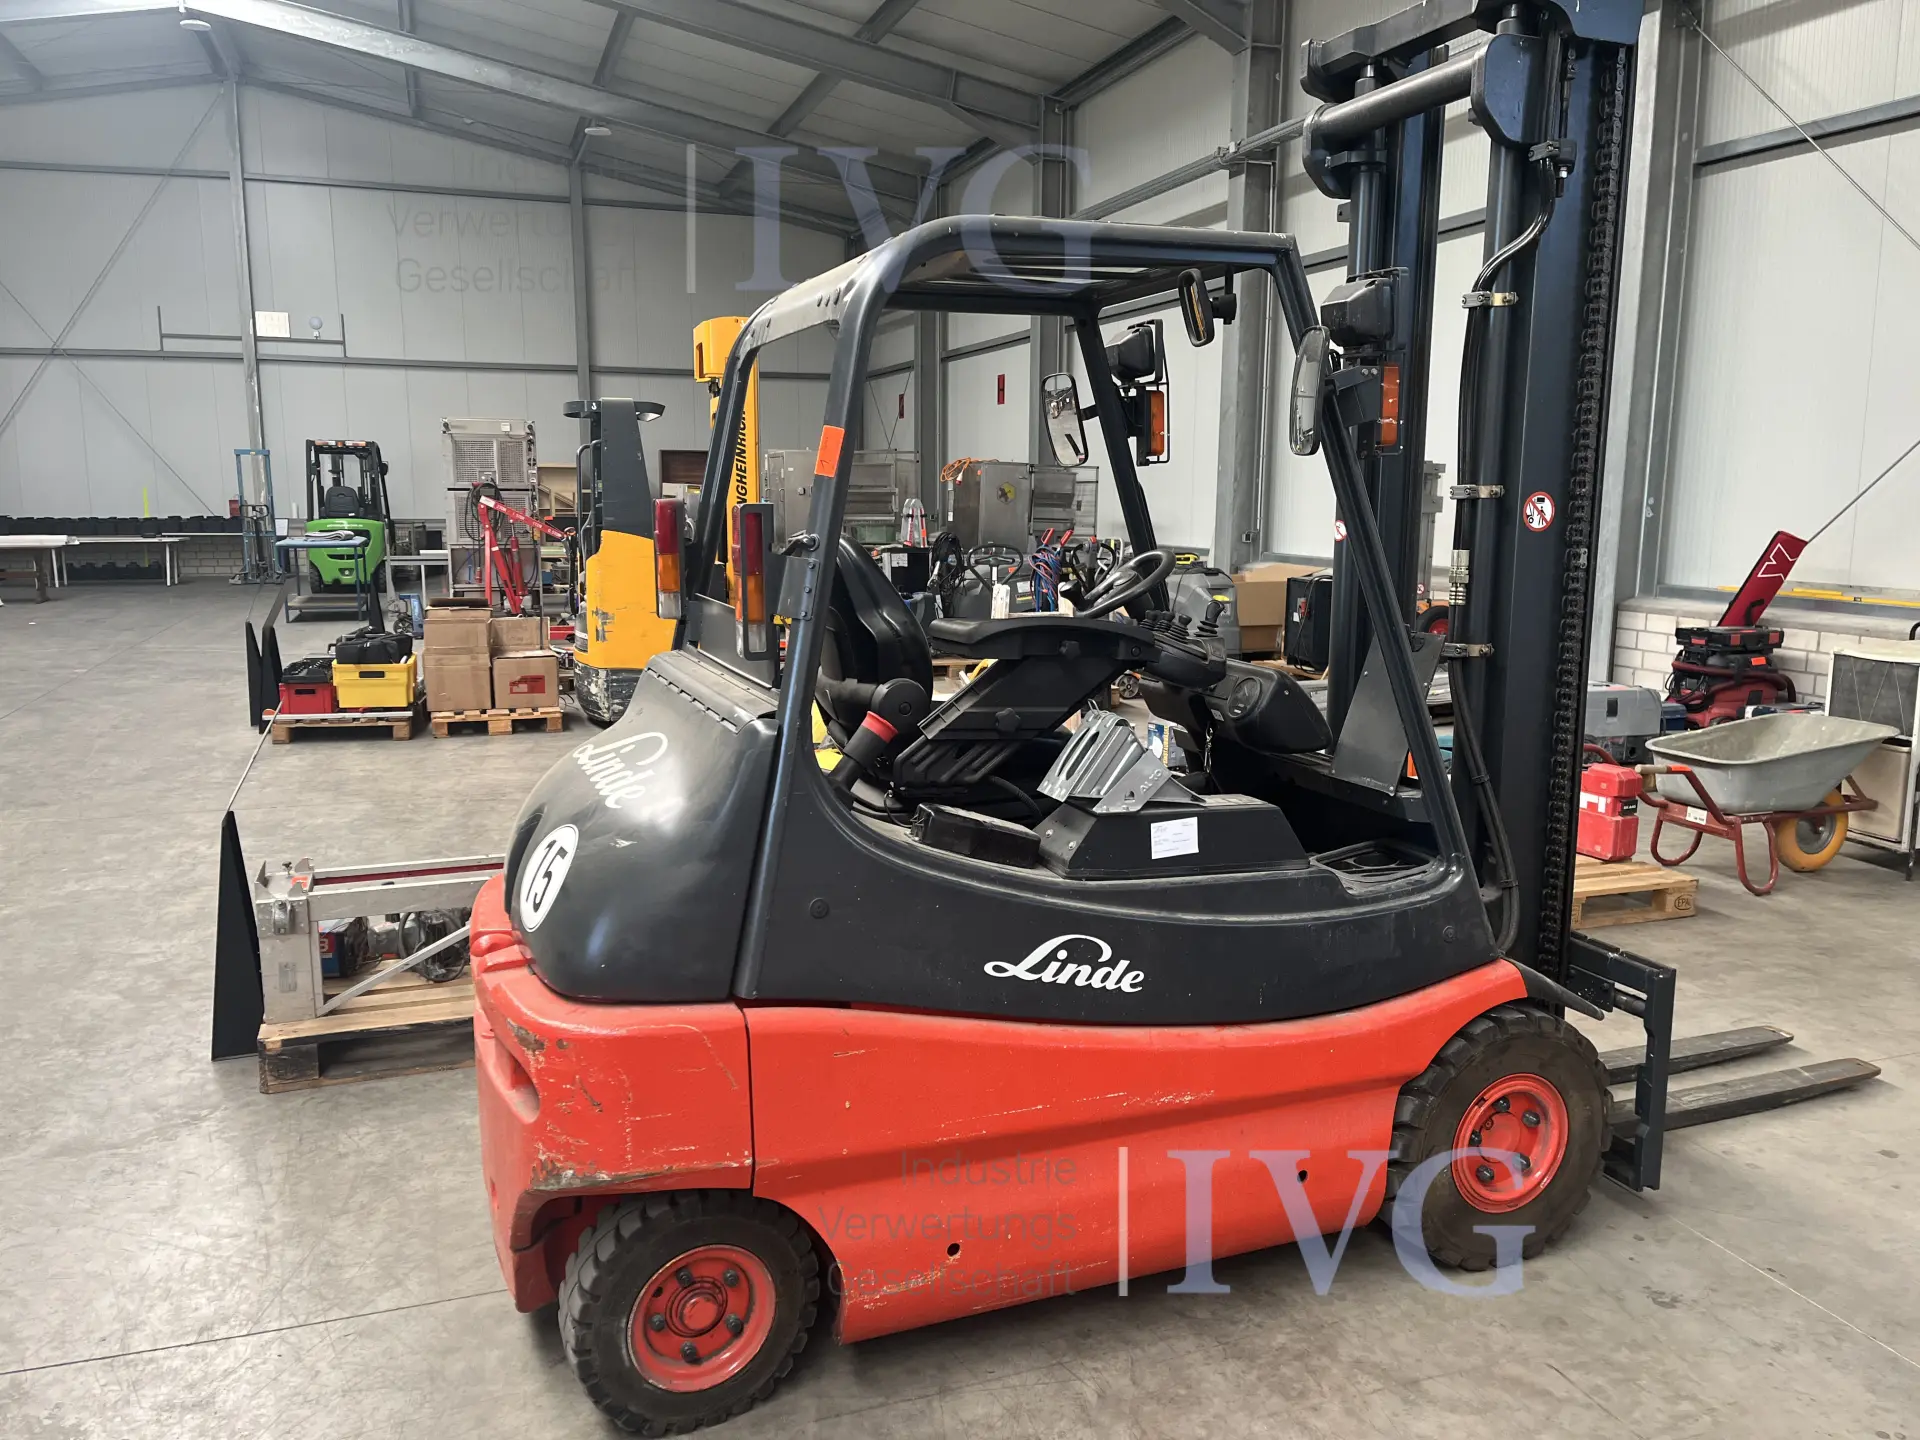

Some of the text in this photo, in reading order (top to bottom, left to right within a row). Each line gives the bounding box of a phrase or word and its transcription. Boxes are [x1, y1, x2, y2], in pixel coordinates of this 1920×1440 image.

[573, 732, 668, 809] Linde
[526, 840, 568, 913] 15
[983, 934, 1145, 993] Linde
